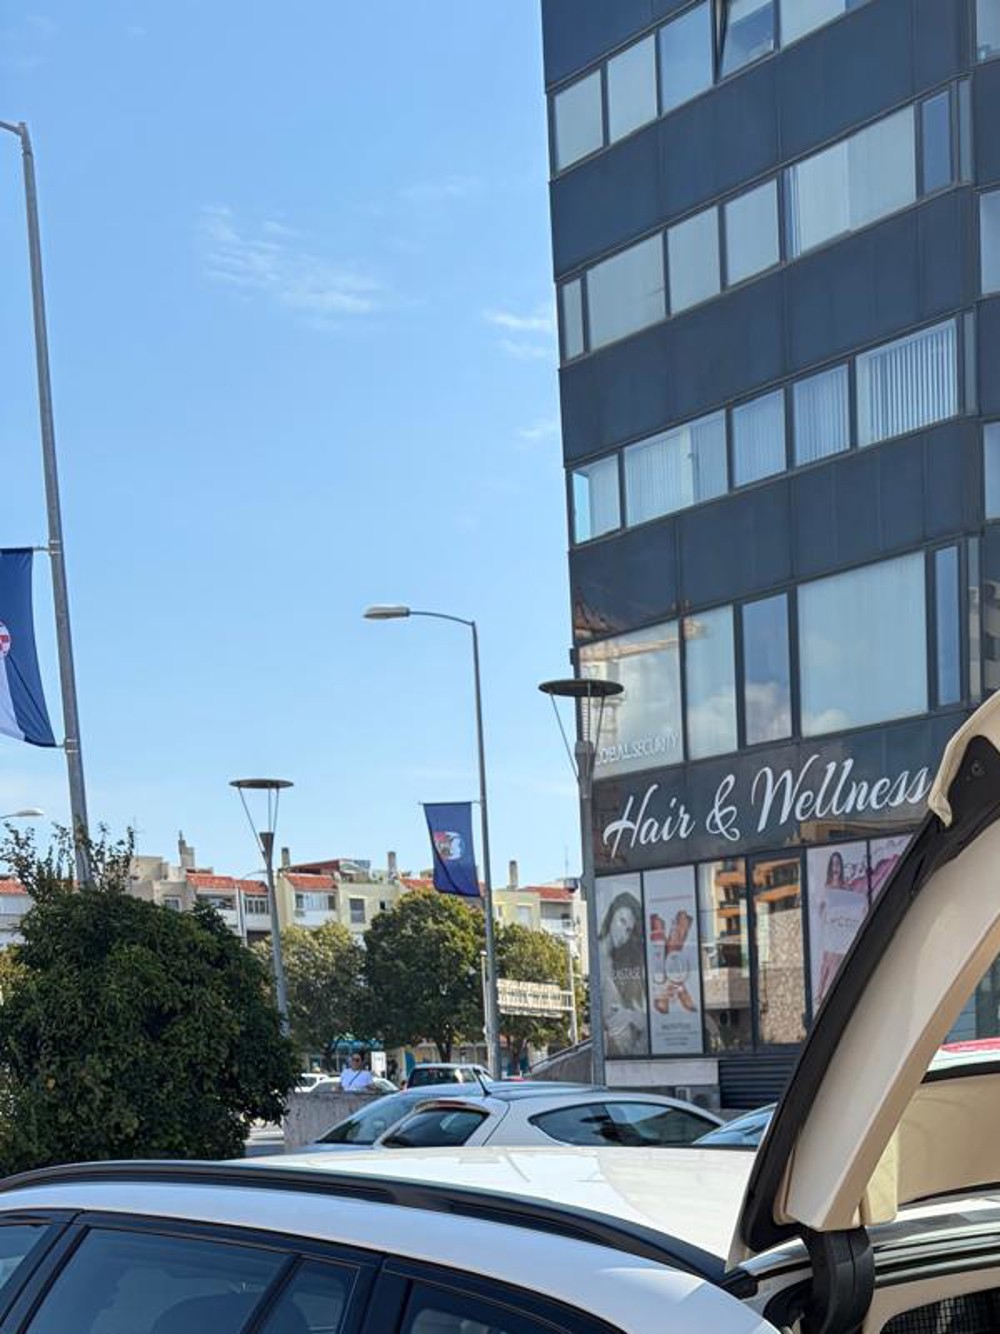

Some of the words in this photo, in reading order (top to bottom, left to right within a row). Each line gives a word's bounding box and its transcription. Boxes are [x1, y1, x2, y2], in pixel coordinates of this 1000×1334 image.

[603, 784, 695, 859] Hair
[705, 774, 741, 842] &
[750, 754, 932, 833] Wellness
